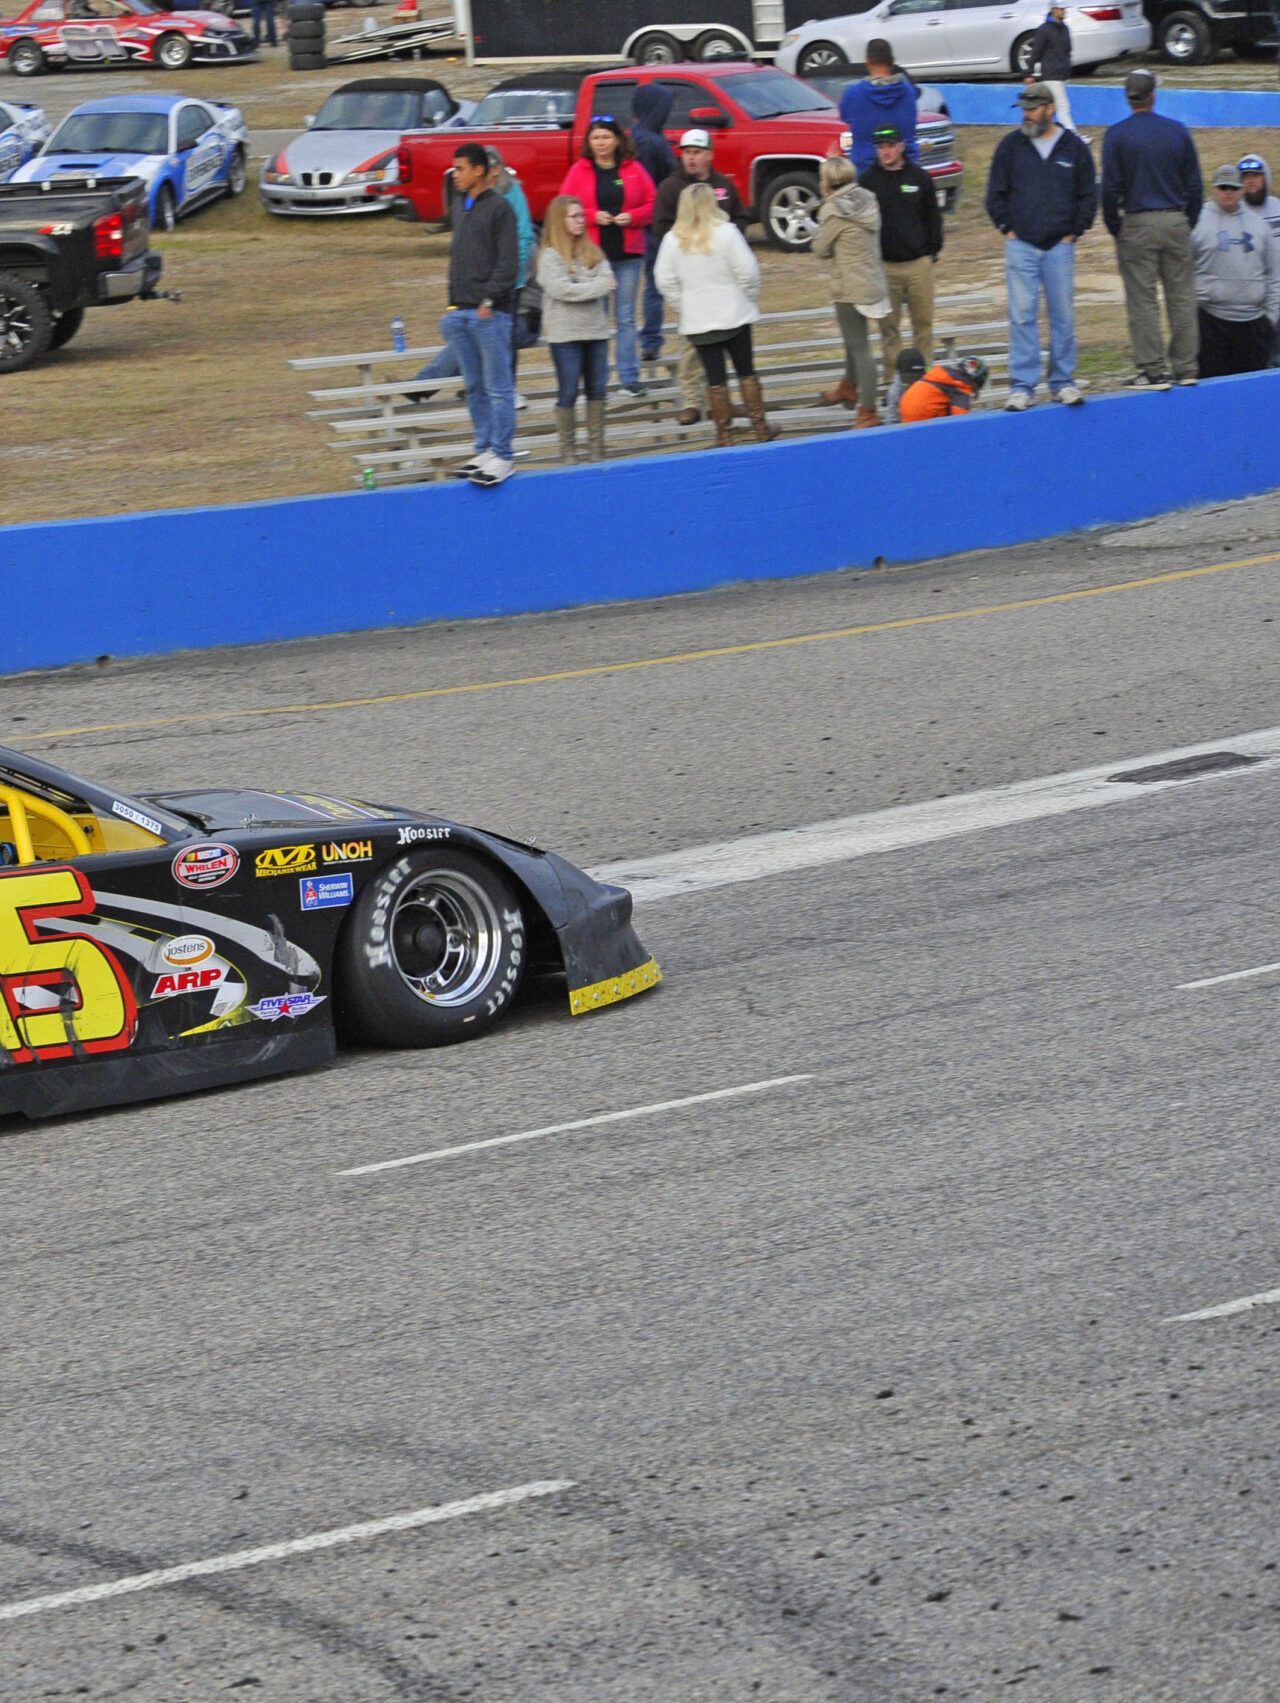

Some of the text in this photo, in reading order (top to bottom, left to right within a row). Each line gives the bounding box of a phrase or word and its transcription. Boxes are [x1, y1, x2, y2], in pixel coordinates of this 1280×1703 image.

[114, 803, 134, 818] 3050
[139, 816, 160, 832] 1375
[321, 840, 372, 862] UNOH
[185, 858, 228, 873] WHELEN
[295, 861, 318, 873] WEAR
[318, 881, 349, 892] SHERWIN
[167, 942, 206, 960] jostens
[154, 968, 222, 995] ARP
[260, 998, 284, 1010] FIVE
[287, 994, 311, 1005] STAR
